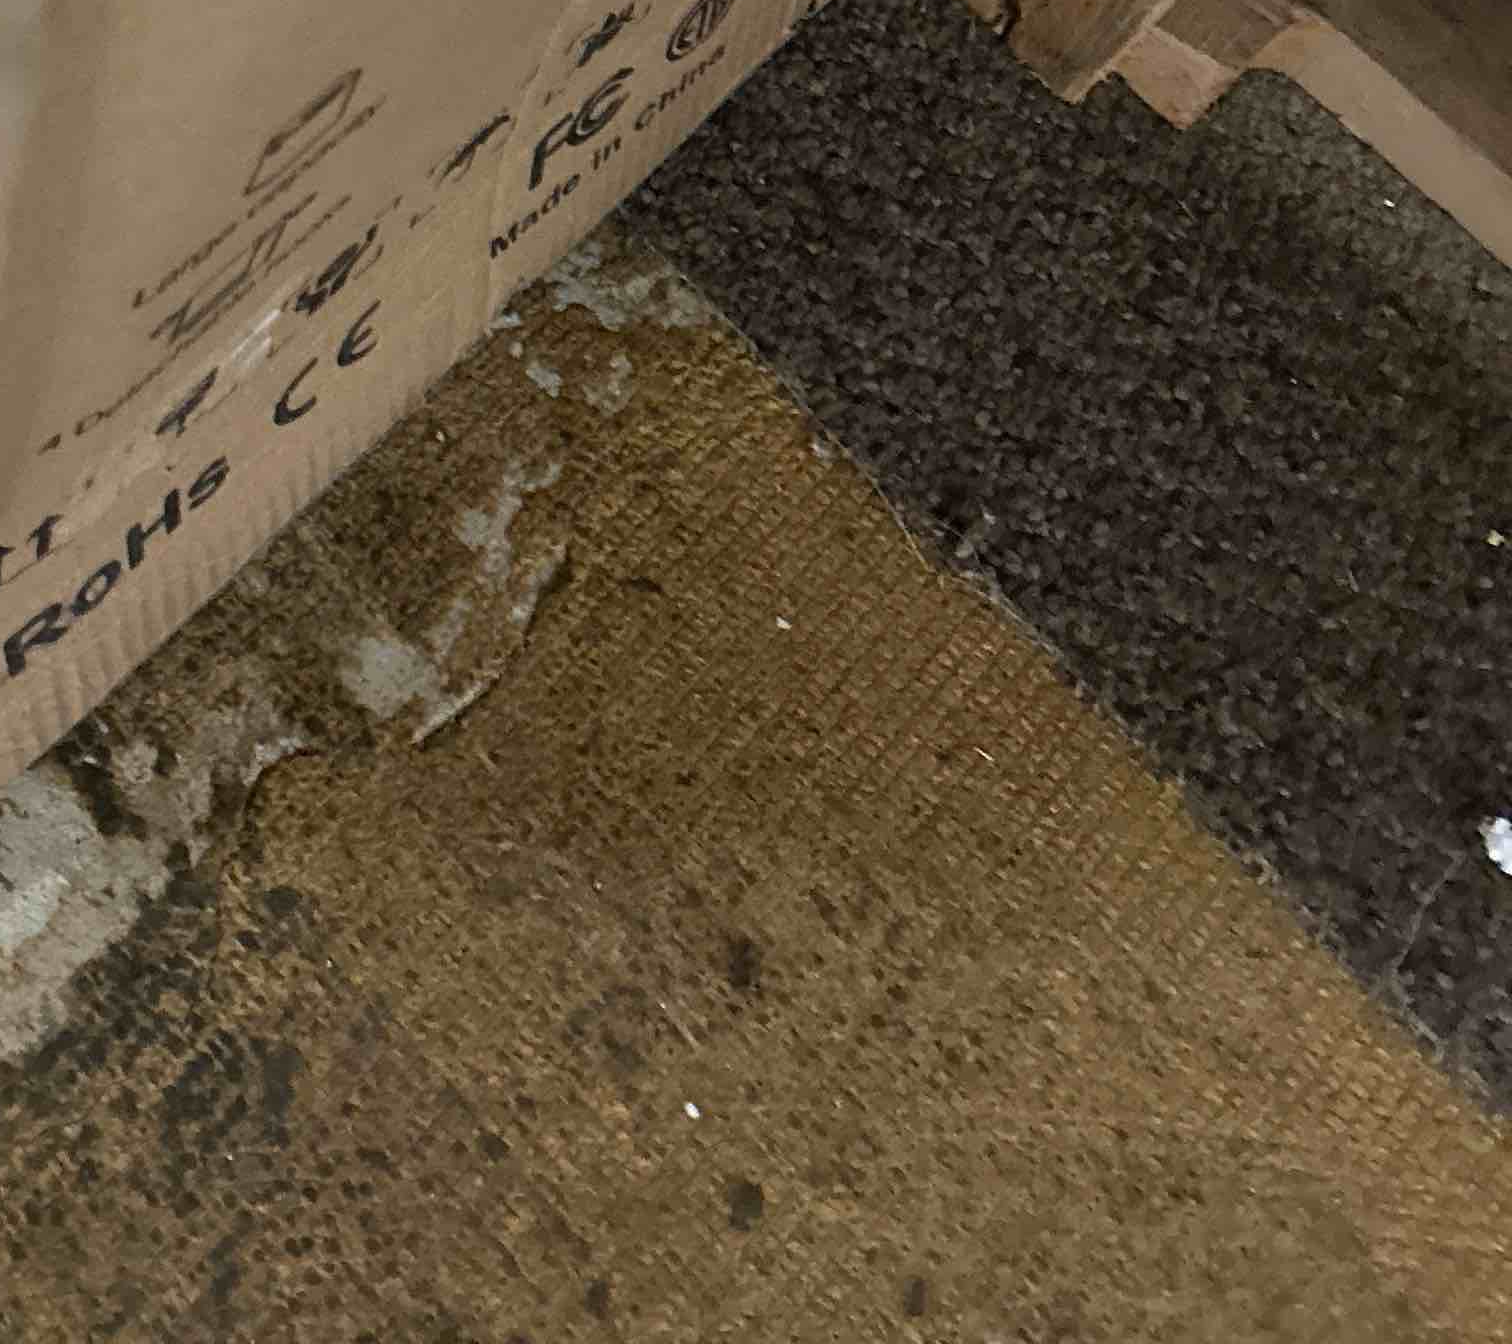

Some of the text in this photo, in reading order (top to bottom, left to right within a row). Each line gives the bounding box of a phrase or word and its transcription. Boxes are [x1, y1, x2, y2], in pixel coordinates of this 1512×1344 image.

[488, 172, 580, 260] Made
[592, 135, 623, 172] in
[633, 43, 727, 132] China
[272, 296, 384, 428] CE
